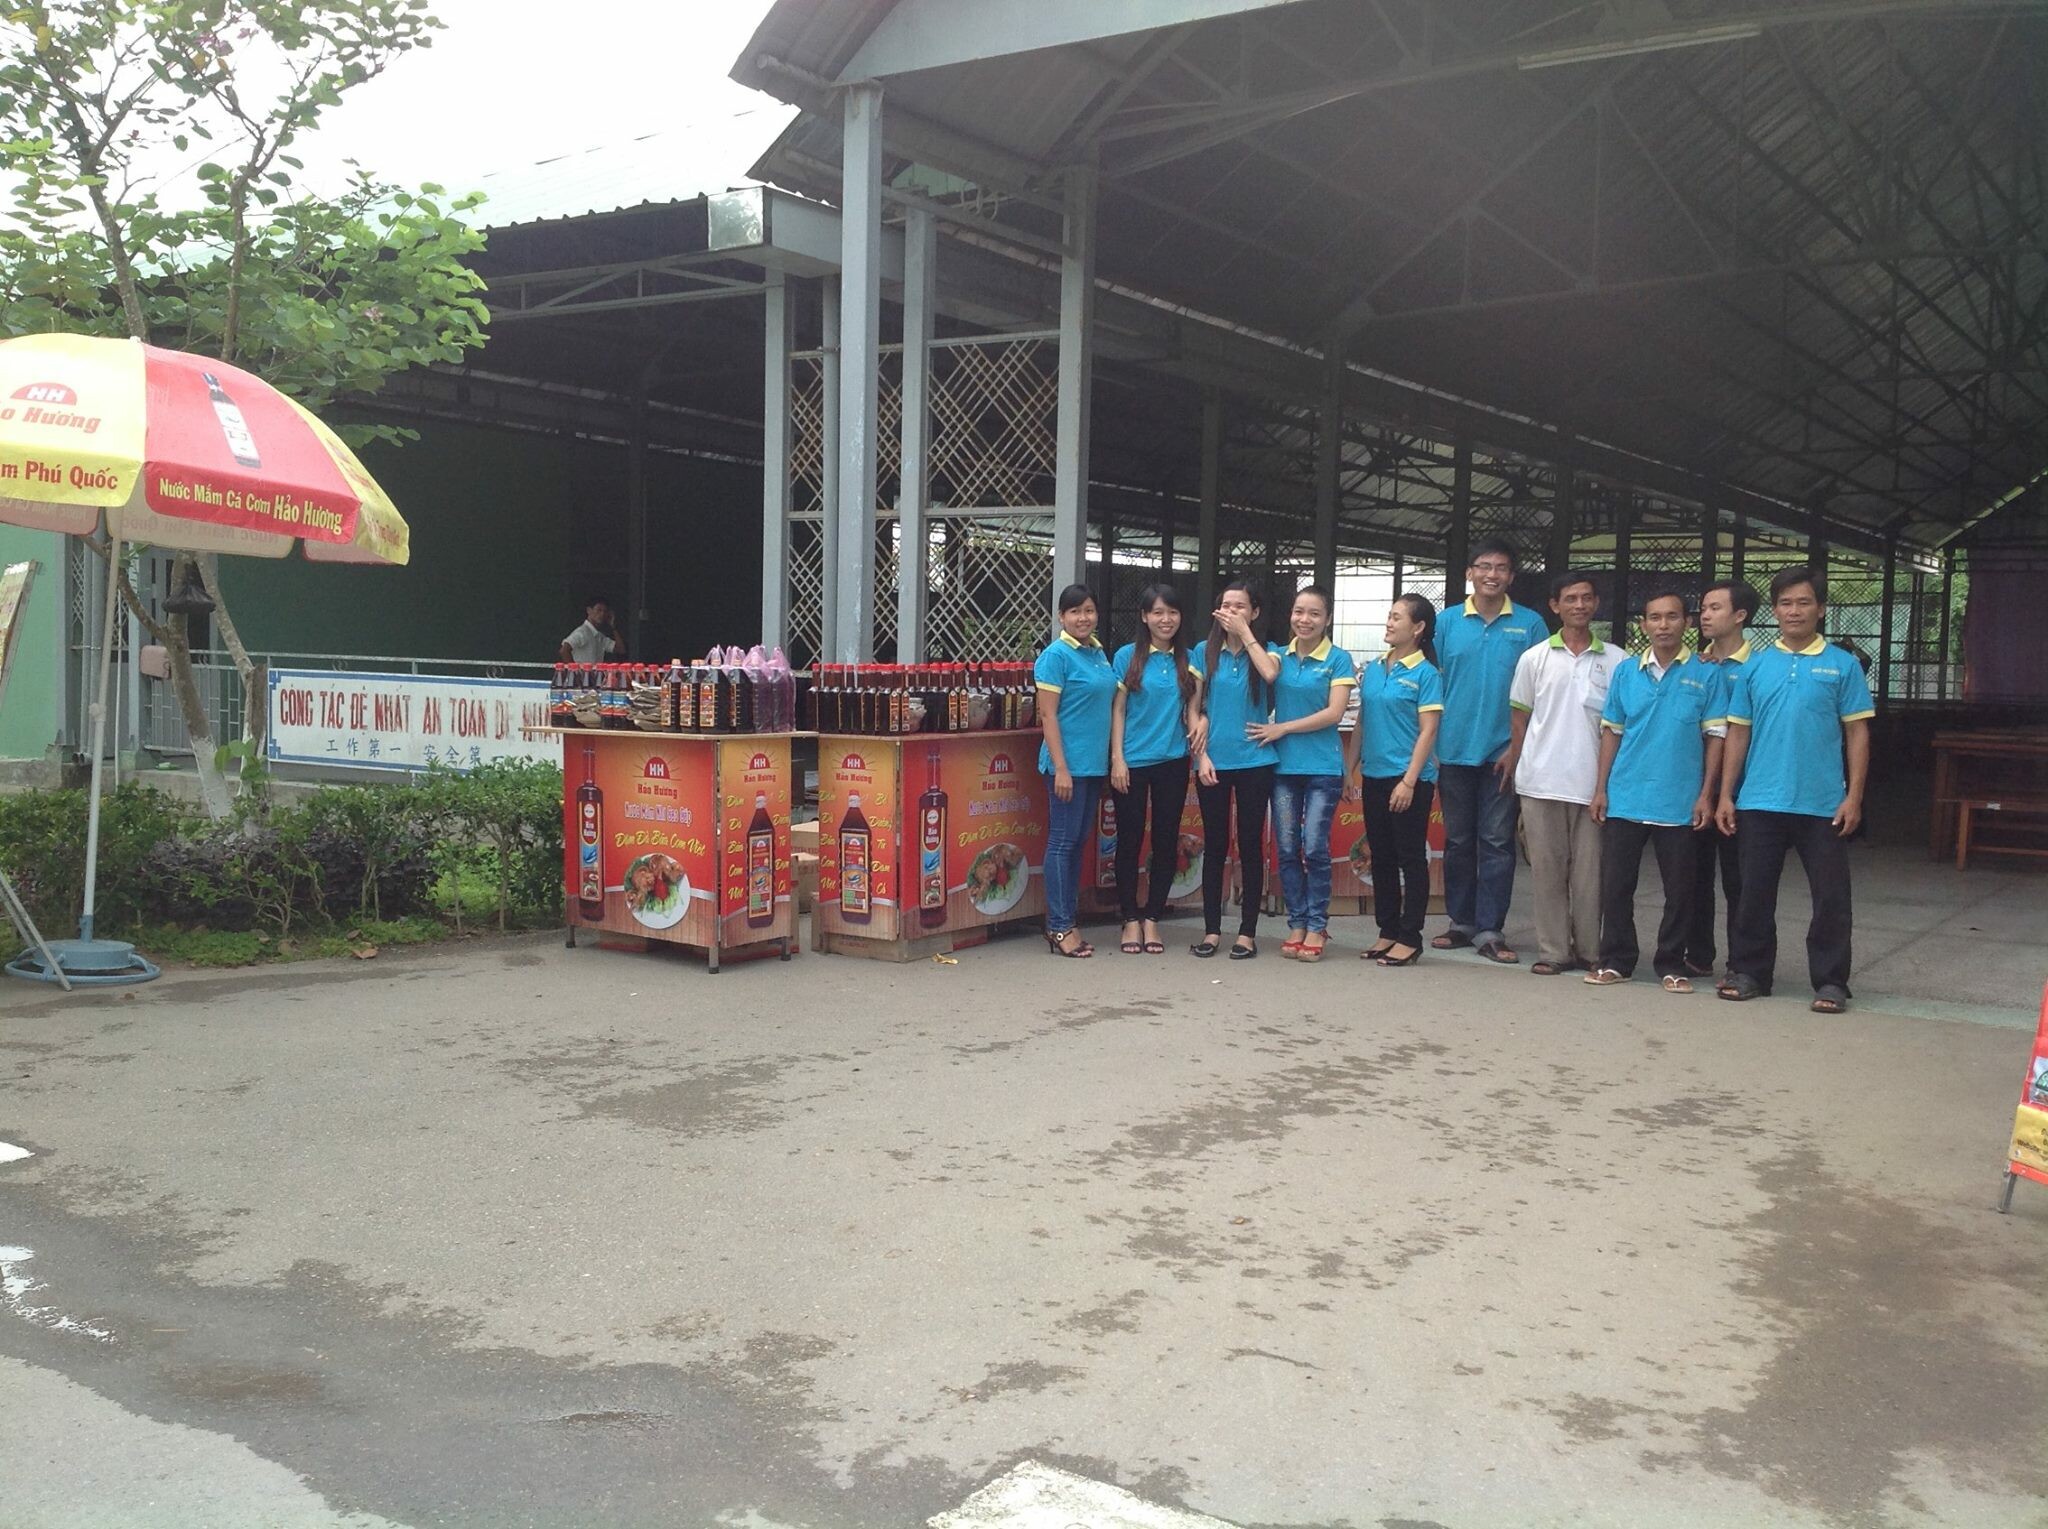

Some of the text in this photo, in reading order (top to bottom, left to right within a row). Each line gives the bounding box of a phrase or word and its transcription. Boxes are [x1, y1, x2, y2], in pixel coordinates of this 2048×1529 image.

[26, 386, 67, 402] HH
[22, 407, 102, 434] Hương
[25, 460, 62, 484] Phú
[69, 465, 119, 490] Quốc
[159, 478, 343, 535] Nước Mắm Cá Cơm Hảo Hương
[320, 683, 345, 729] TÁC
[423, 697, 441, 735] AN
[649, 763, 665, 777] HH
[753, 758, 766, 768] HH
[847, 758, 861, 768] HH
[995, 759, 1008, 772] HH
